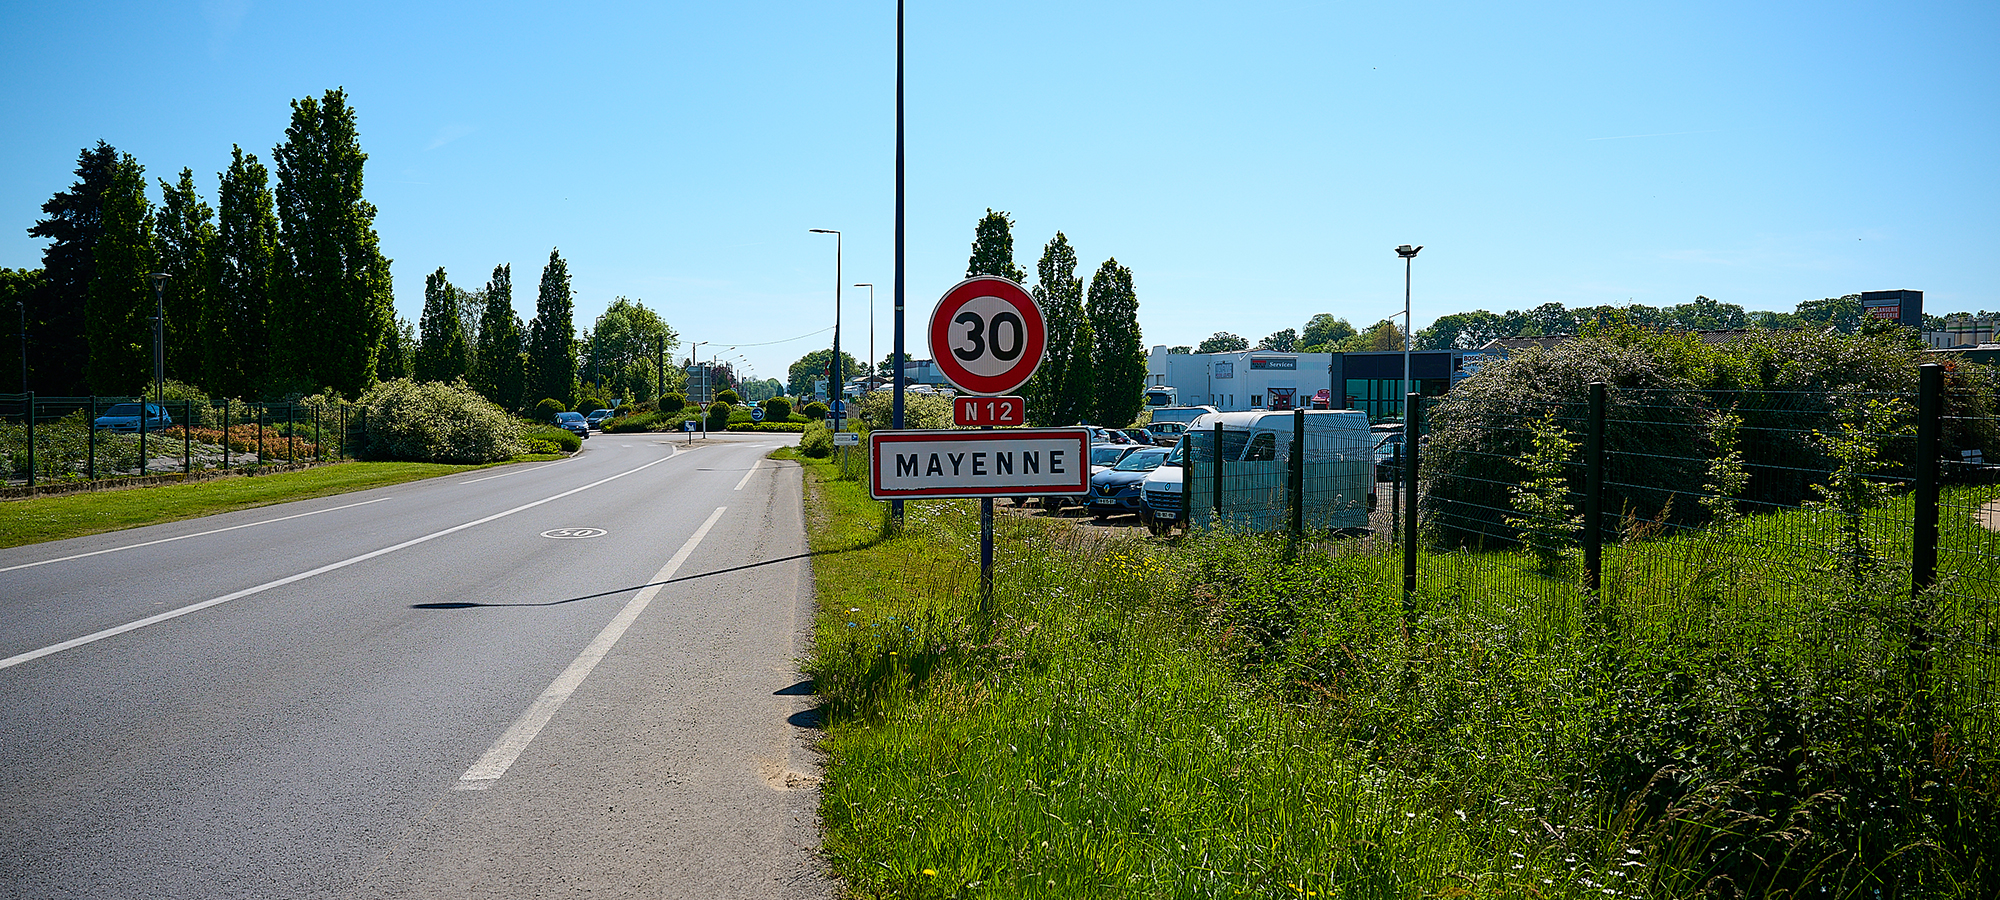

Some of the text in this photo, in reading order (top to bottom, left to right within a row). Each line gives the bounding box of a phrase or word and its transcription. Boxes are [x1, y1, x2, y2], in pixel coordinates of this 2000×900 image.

[953, 311, 1024, 362] 30
[966, 402, 1013, 421] N 12
[896, 450, 1065, 478] MAYENNE
